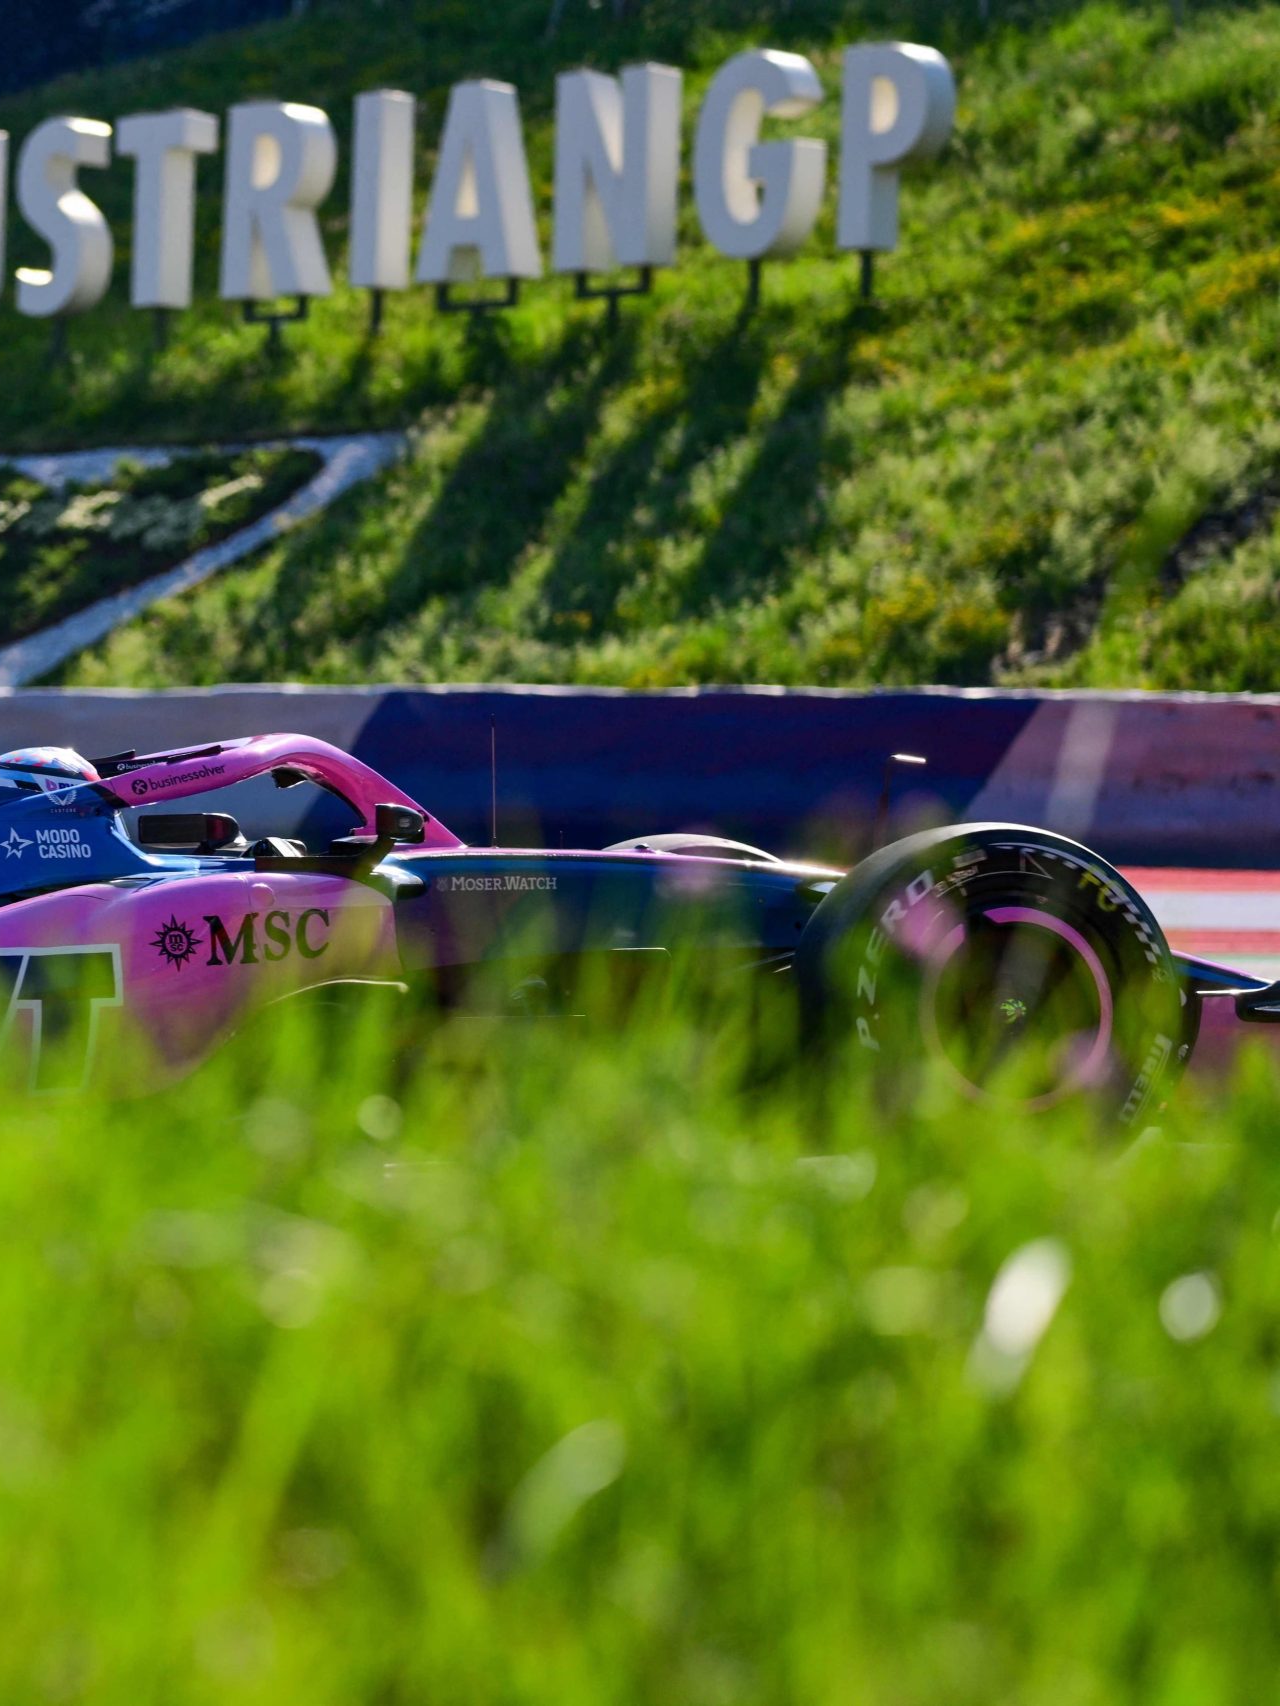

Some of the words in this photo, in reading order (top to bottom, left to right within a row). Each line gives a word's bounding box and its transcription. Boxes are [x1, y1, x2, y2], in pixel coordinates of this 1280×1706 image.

[148, 764, 225, 791] businessolver
[36, 829, 80, 844] MODO
[39, 844, 91, 859] CASINO
[203, 908, 330, 966] MSC
